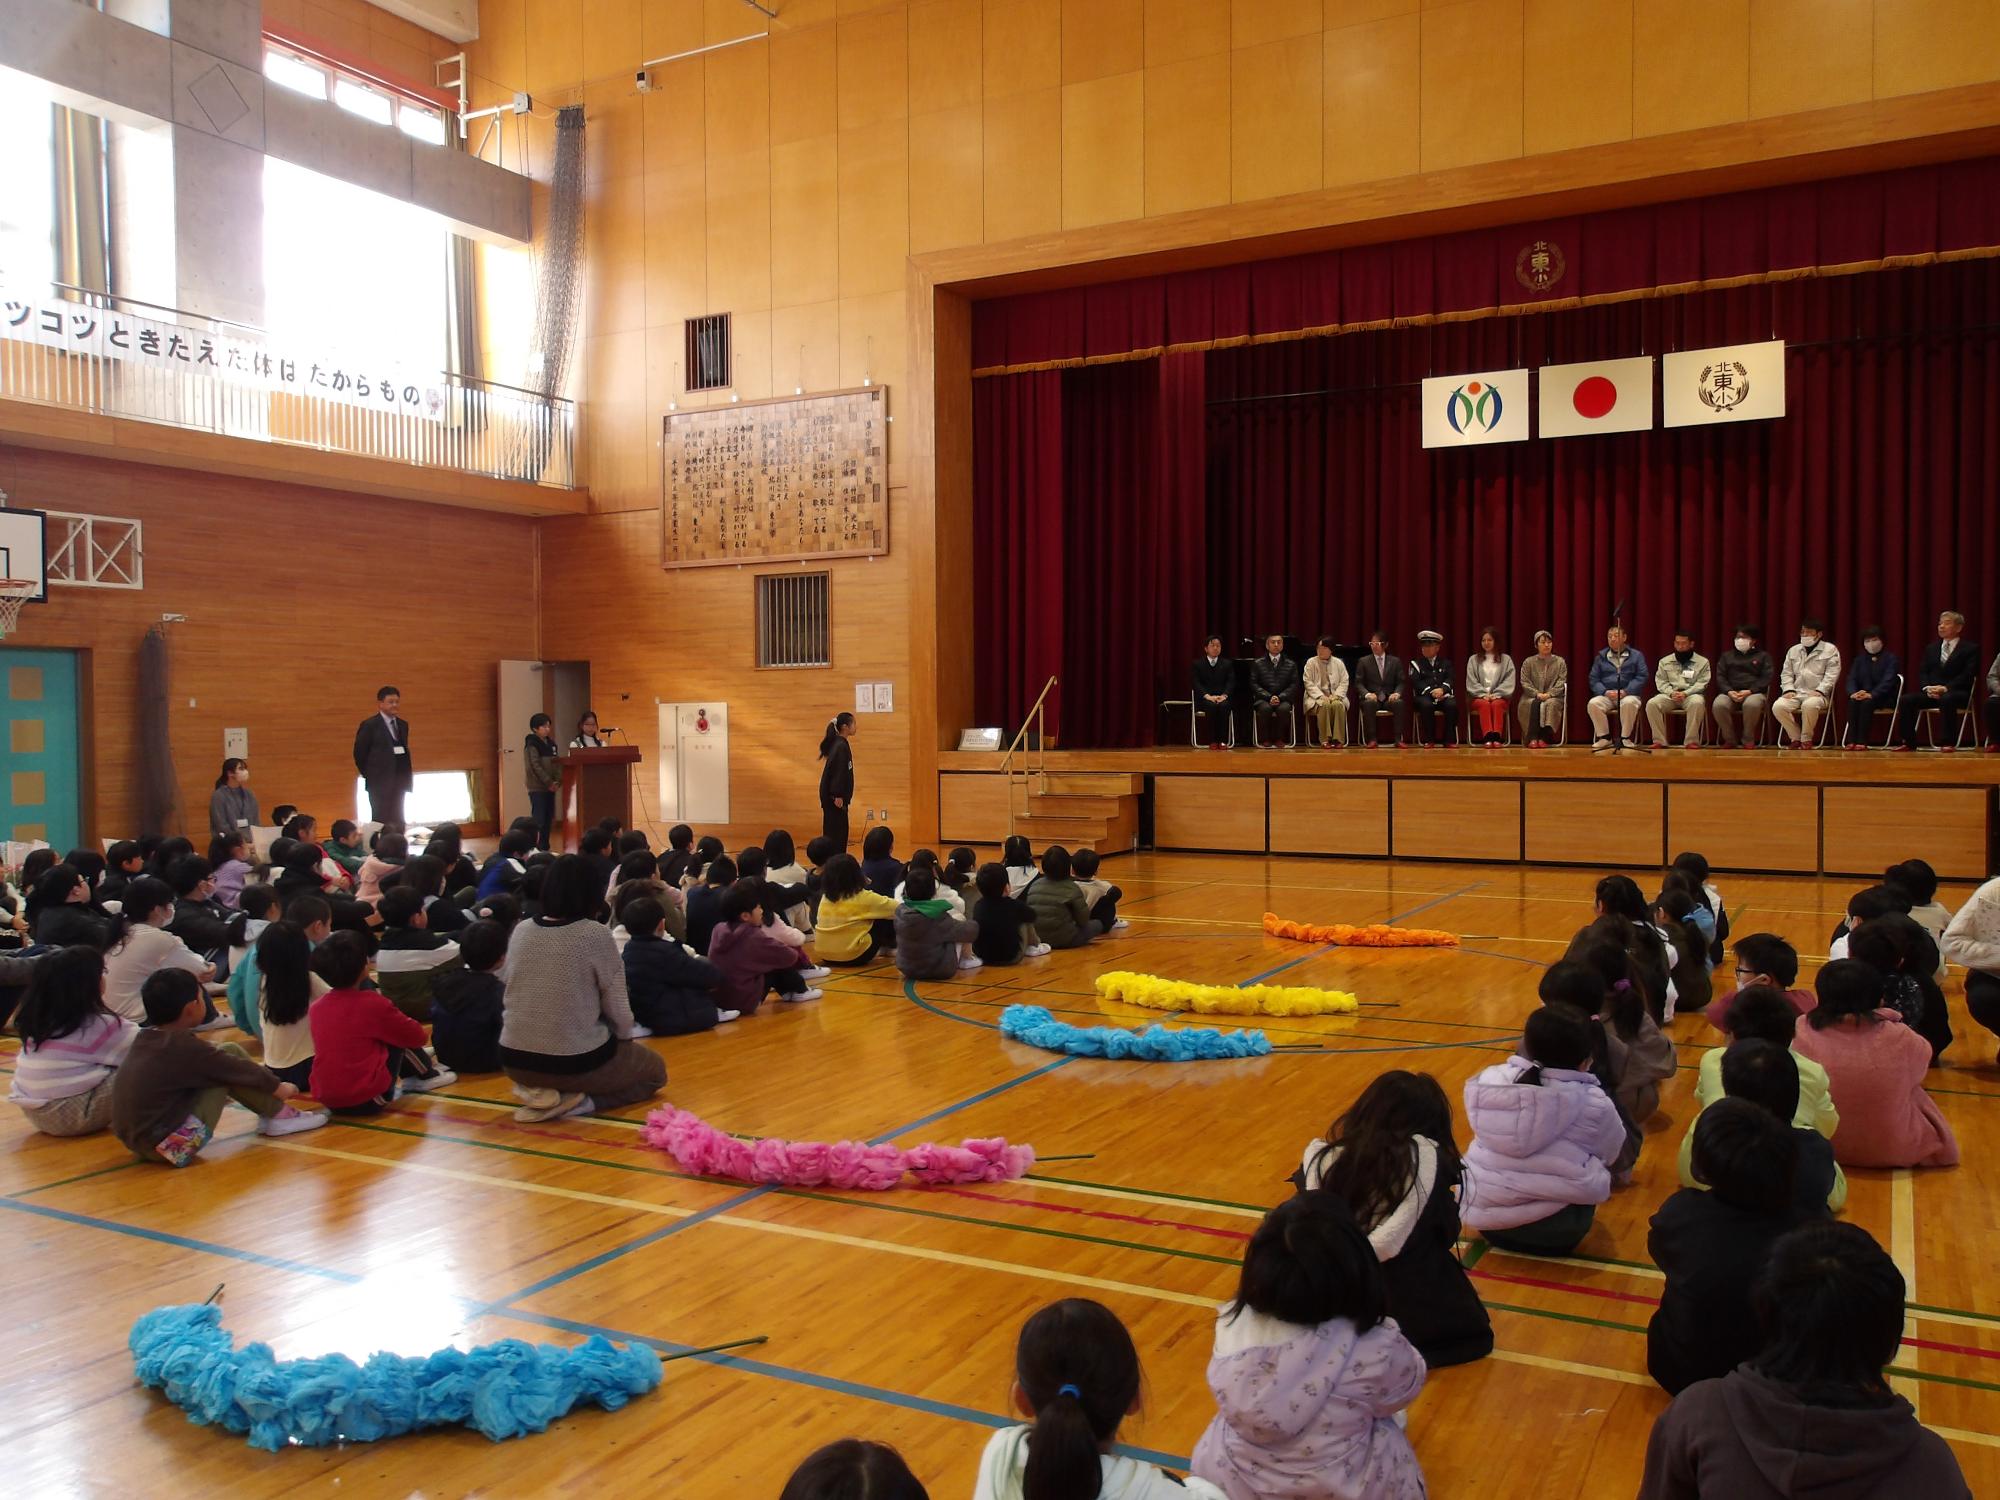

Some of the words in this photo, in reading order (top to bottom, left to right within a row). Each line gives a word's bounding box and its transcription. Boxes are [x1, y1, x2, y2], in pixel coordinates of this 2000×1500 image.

[1531, 240, 1549, 283] 北東小
[310, 363, 420, 406] たからもの
[1713, 361, 1735, 404] 北東小
